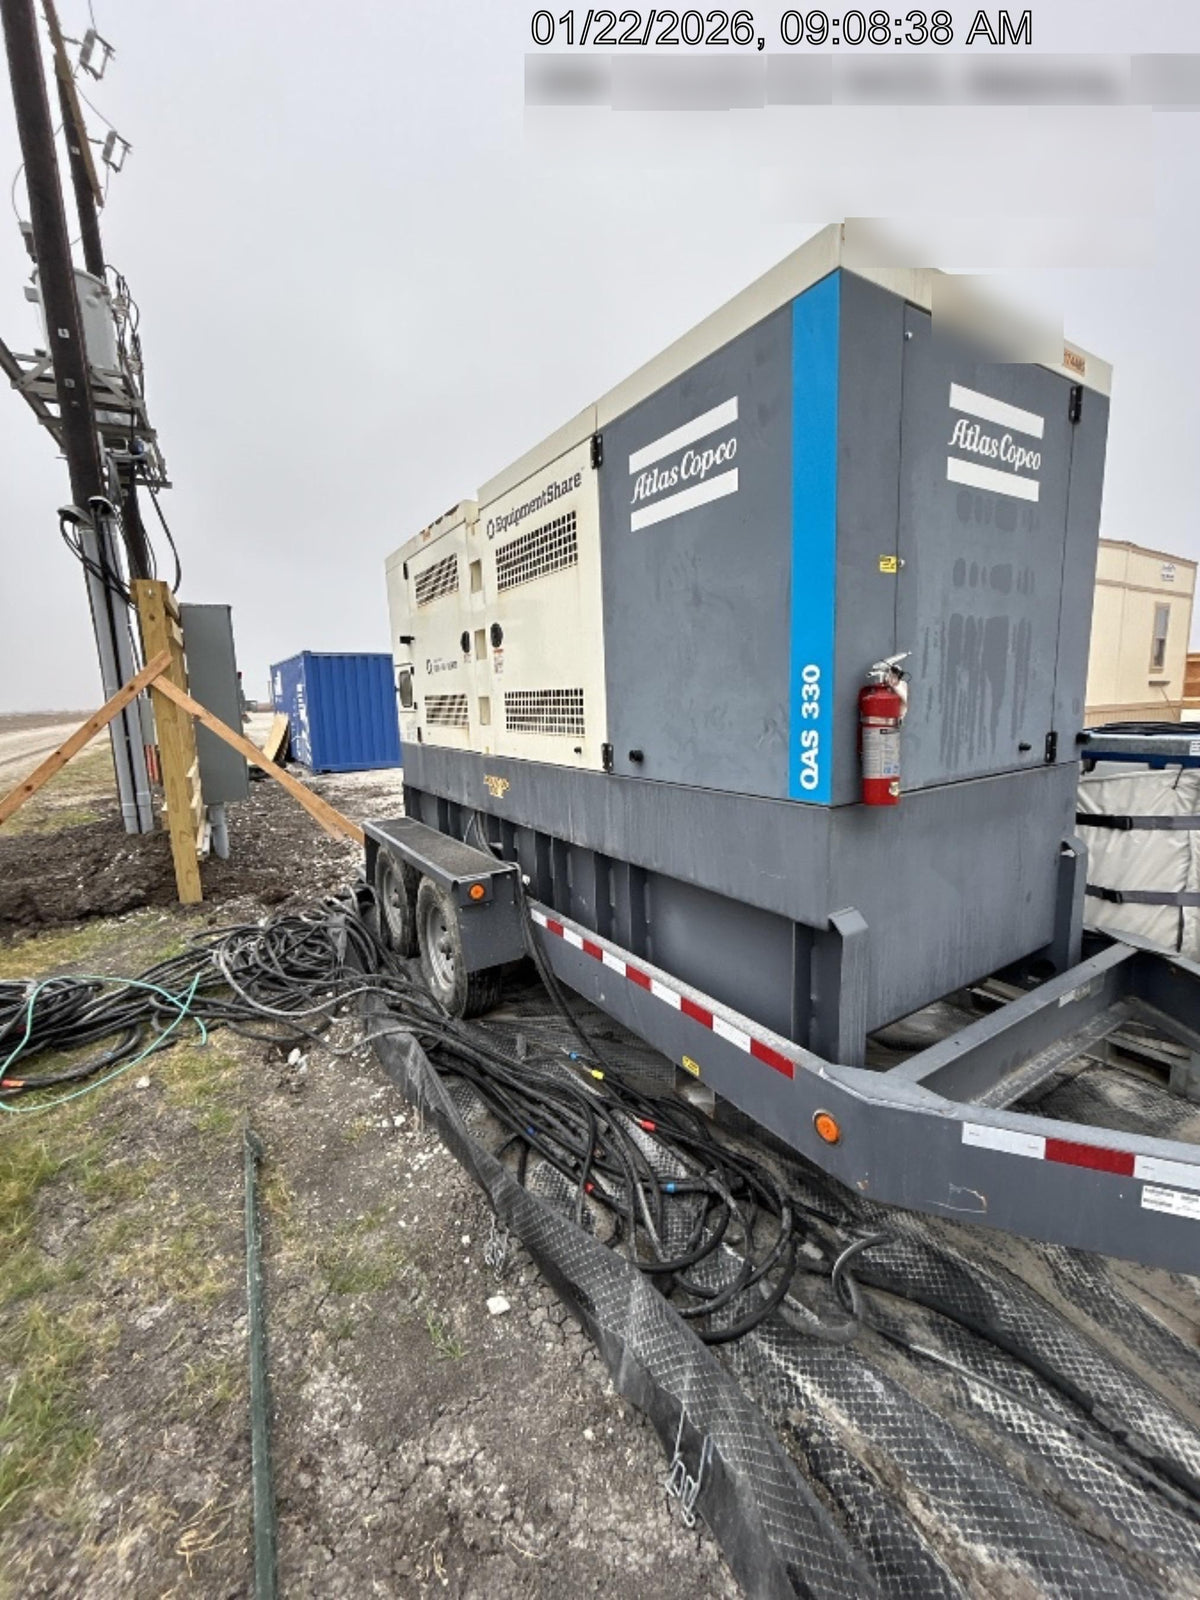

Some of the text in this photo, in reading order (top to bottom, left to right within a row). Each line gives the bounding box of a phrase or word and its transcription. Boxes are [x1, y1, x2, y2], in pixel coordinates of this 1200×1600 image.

[630, 438, 737, 504] Atlas Copco
[947, 418, 1041, 471] Atlas Copco
[495, 471, 582, 533] EquipmentShare
[800, 664, 821, 790] QAS 330
